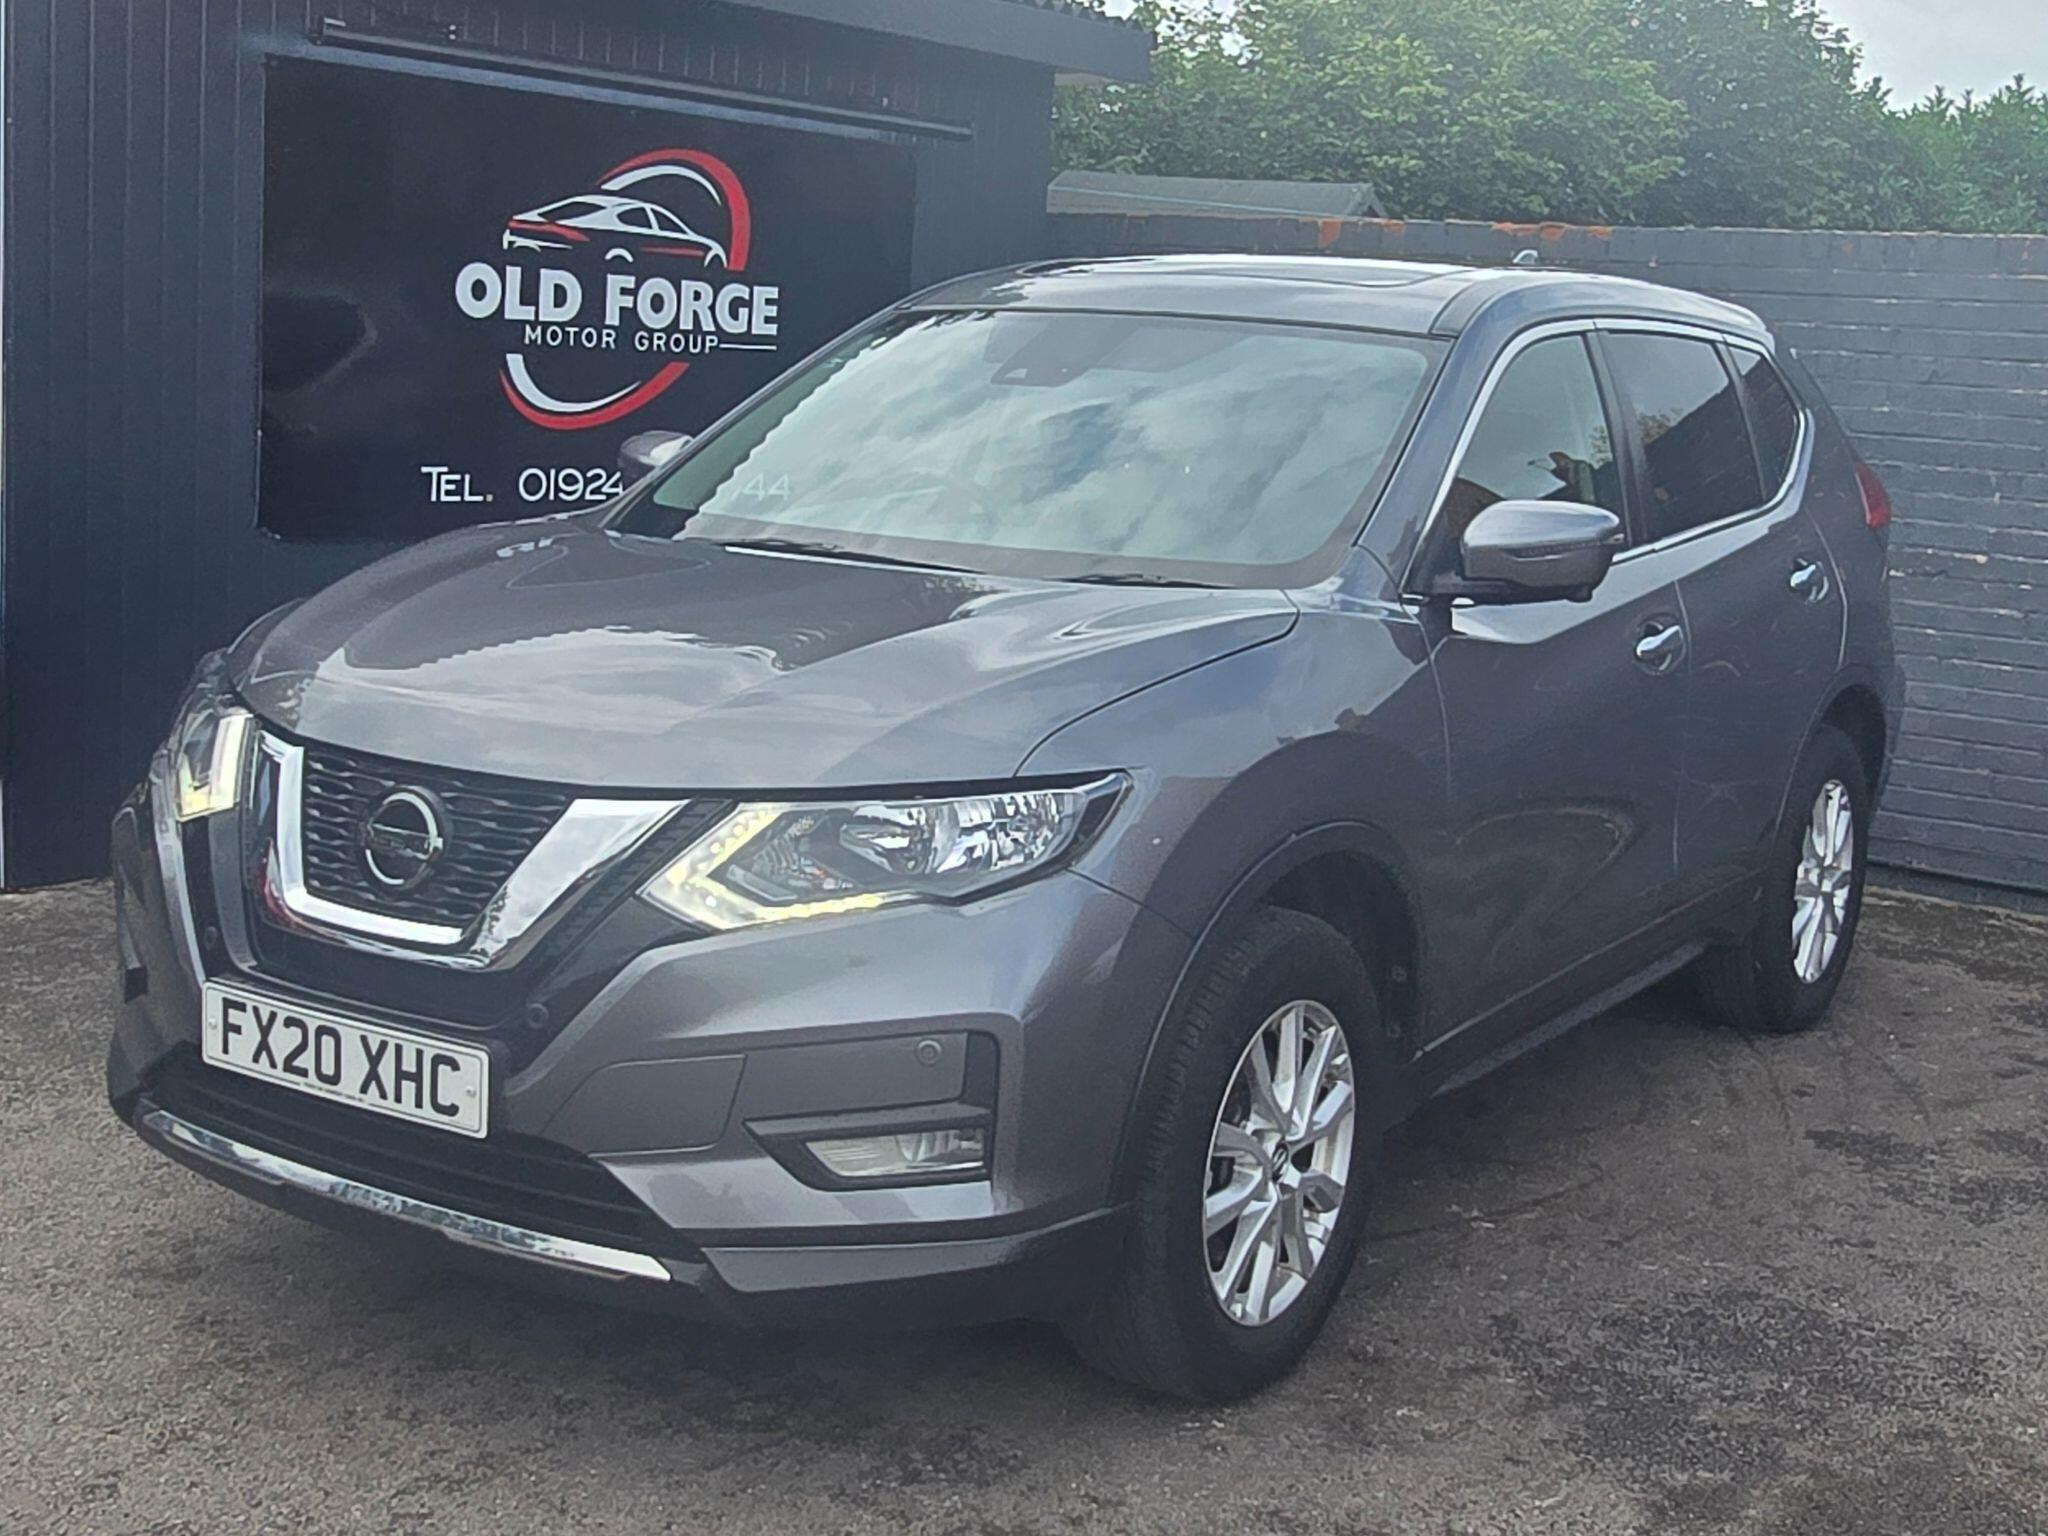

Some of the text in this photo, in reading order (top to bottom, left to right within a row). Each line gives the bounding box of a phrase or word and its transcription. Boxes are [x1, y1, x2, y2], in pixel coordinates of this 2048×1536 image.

[455, 262, 779, 336] OLD FORGE
[523, 325, 720, 354] MOTOR GROUP
[518, 468, 623, 502] 01924
[221, 997, 462, 1118] FX20 XHC
